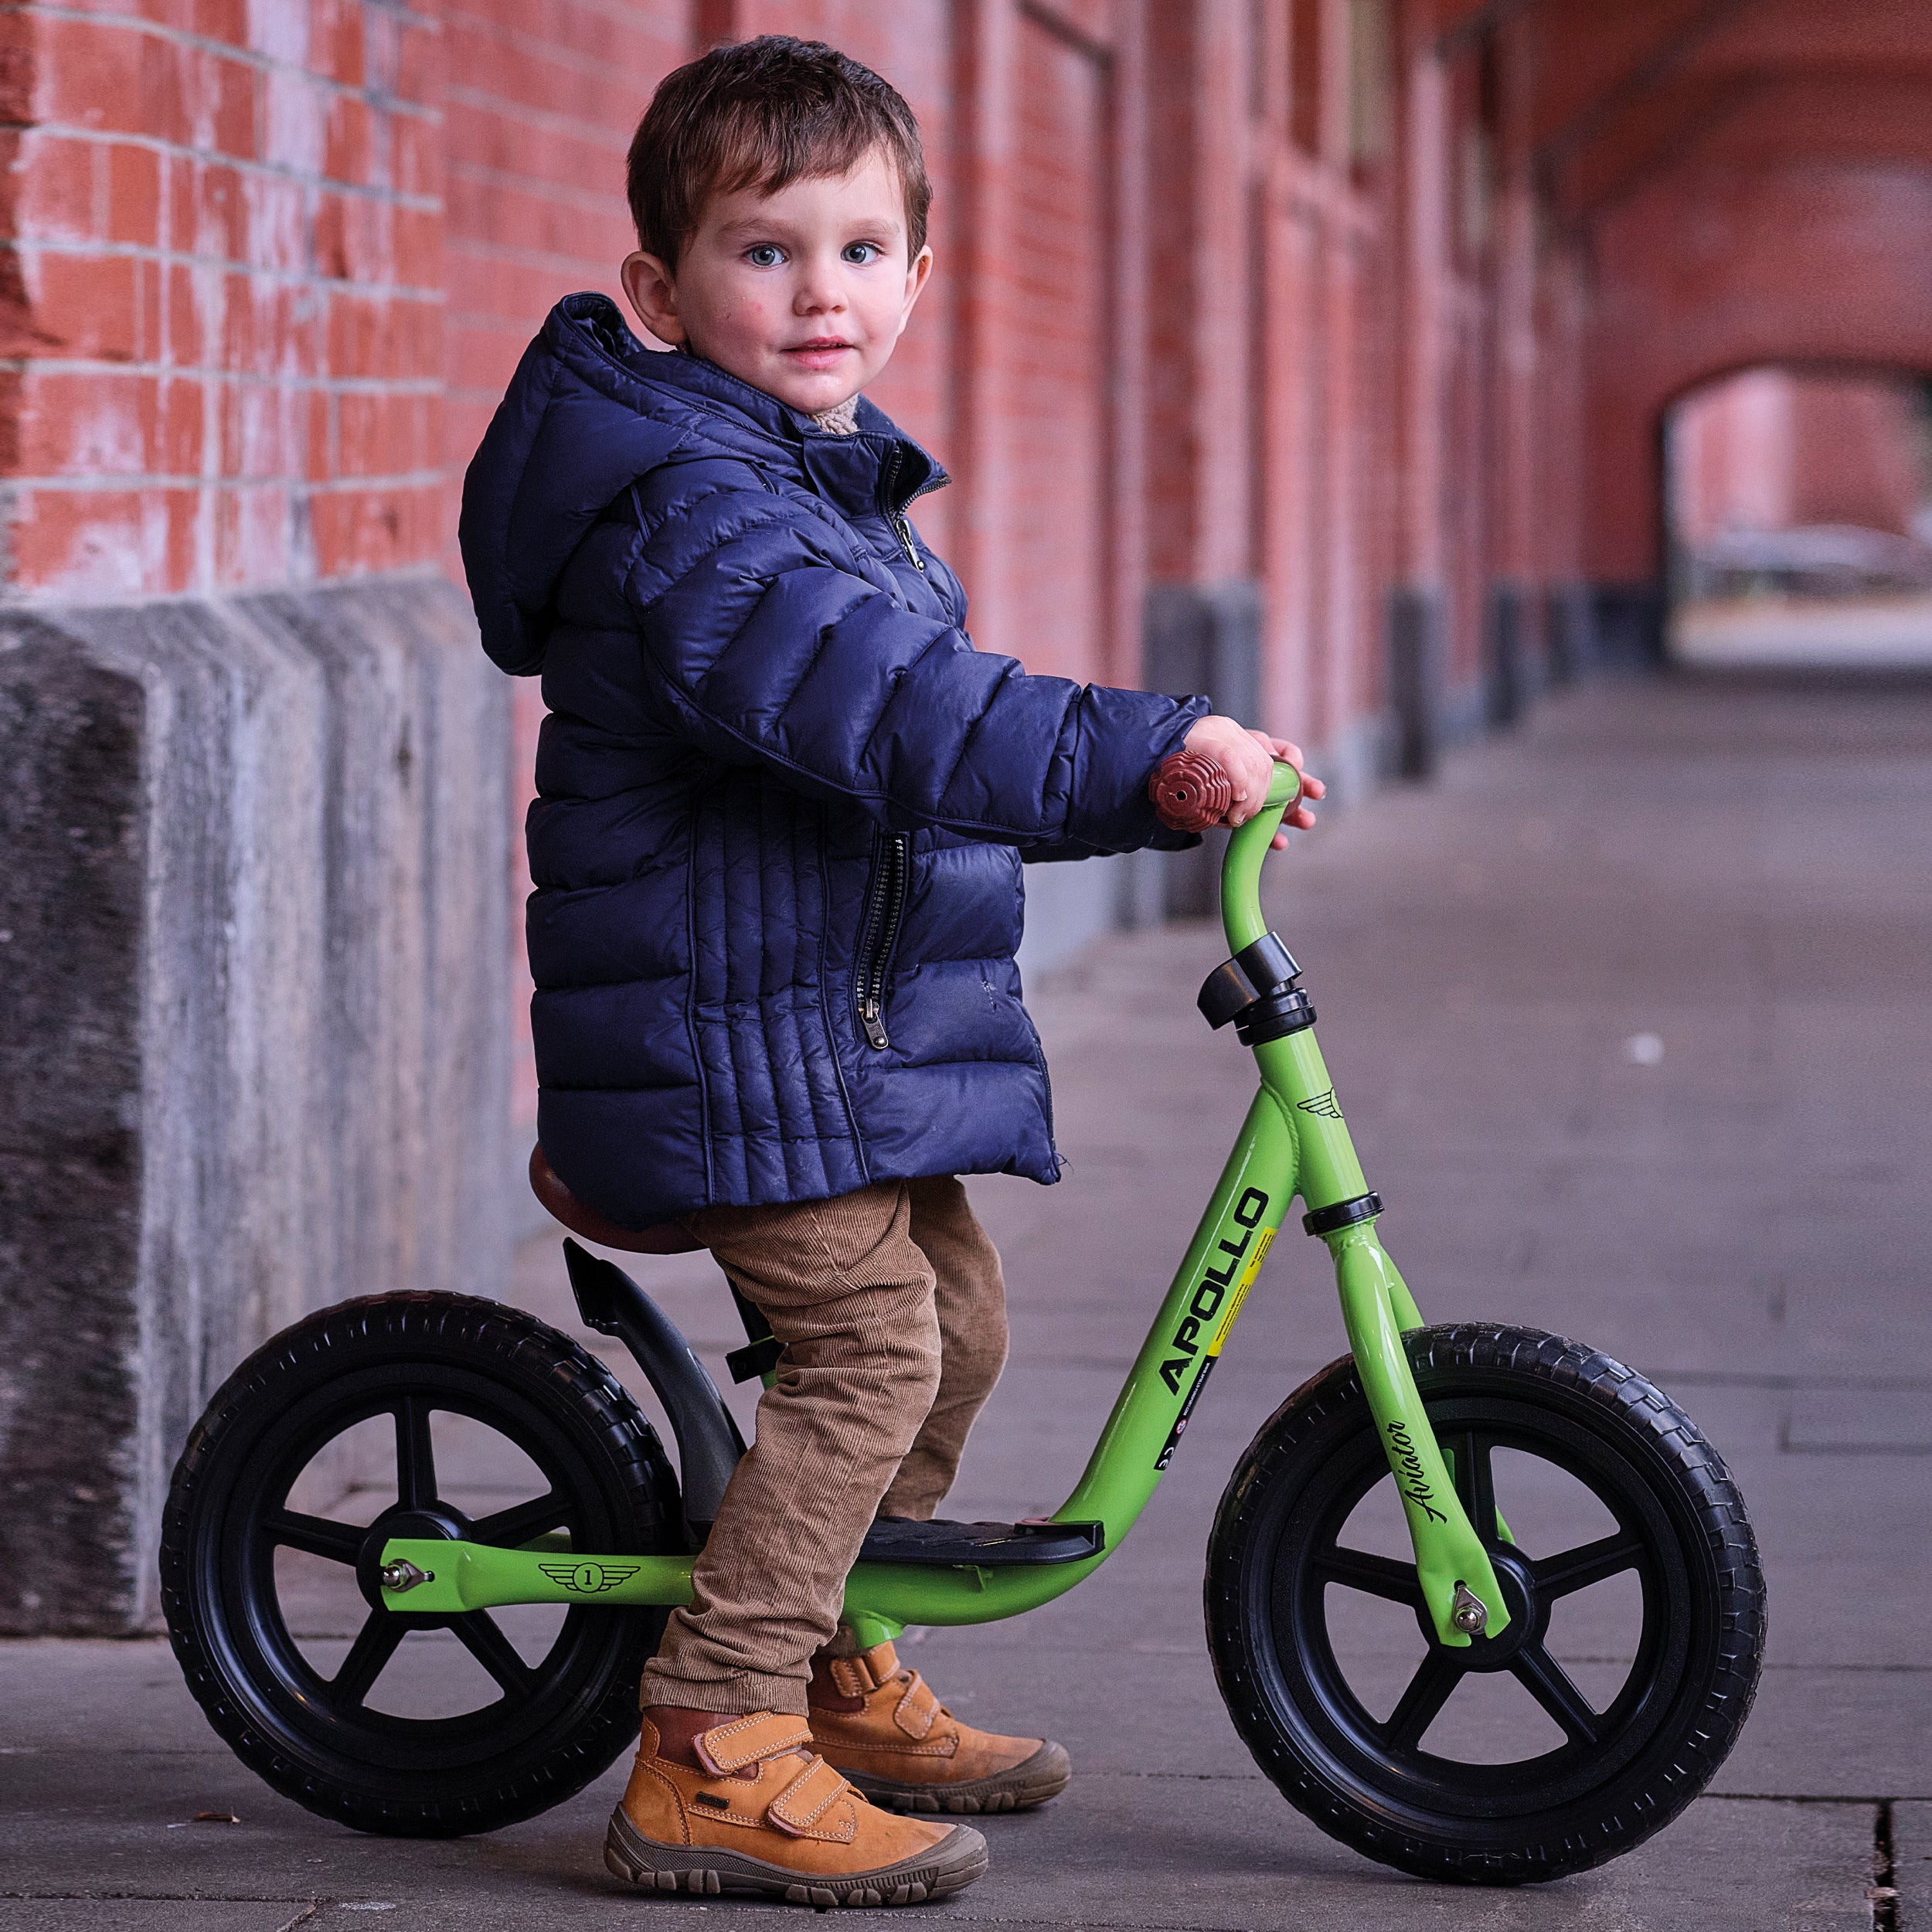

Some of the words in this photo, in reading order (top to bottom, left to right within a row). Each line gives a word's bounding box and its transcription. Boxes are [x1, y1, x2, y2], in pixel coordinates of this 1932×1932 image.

[1159, 1186, 1270, 1396] APOLLO
[1386, 1420, 1447, 1525] Aviator
[584, 1570, 592, 1585] 1
